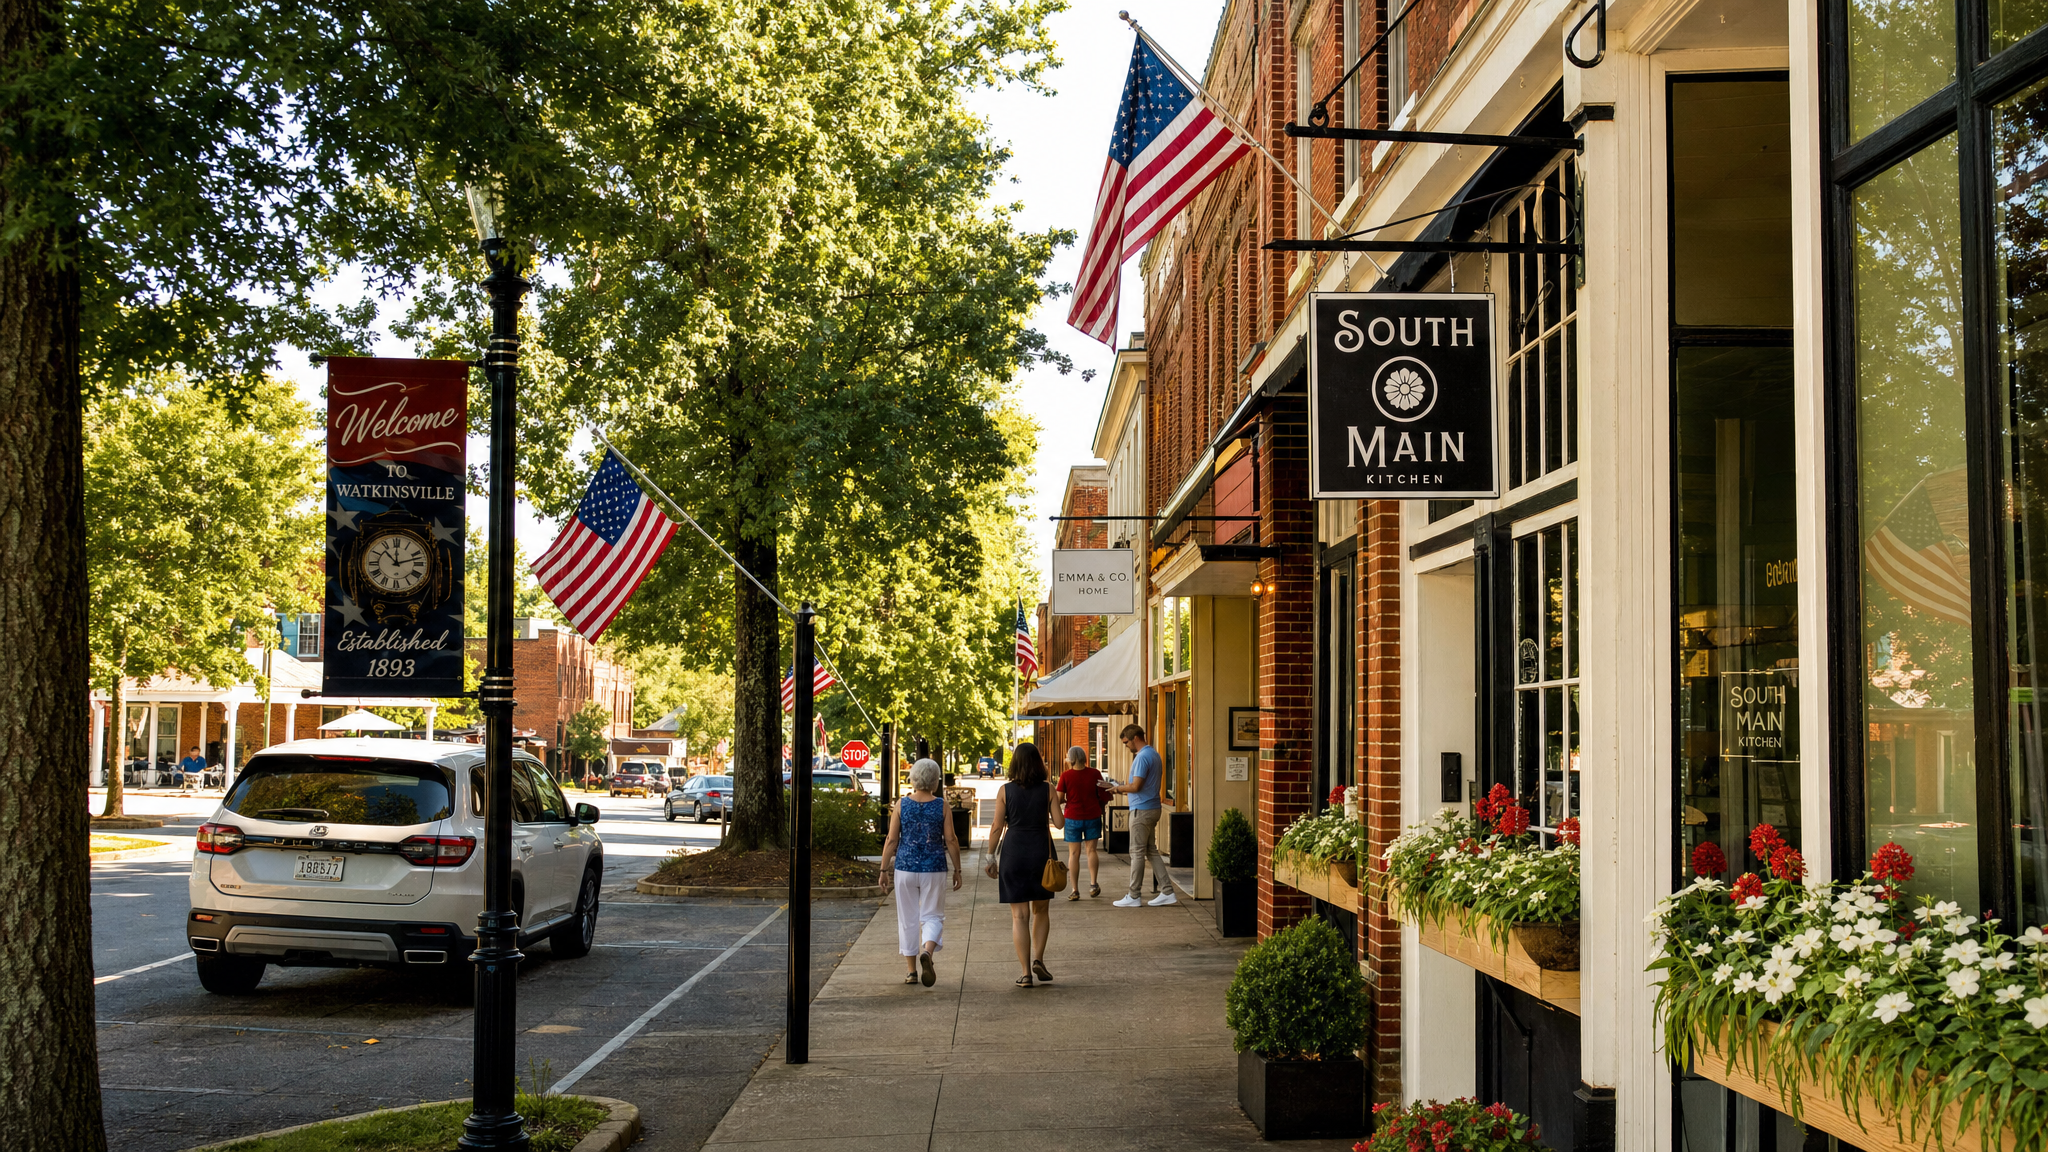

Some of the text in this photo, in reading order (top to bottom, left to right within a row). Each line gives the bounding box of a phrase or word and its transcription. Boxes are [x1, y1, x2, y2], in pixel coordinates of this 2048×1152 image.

[1334, 309, 1474, 353] SOUTH
[335, 396, 459, 446] Welcome
[1346, 425, 1465, 468] MAIN
[386, 464, 408, 479] TO
[1366, 474, 1443, 484] KITCHEN
[336, 484, 455, 500] WATKINSVILLE
[1058, 573, 1129, 582] EMMA & CO.
[337, 628, 449, 652] Established
[366, 658, 416, 677] 1893
[1730, 685, 1786, 708] SOUTH
[1736, 711, 1783, 731] MAIN
[1738, 736, 1782, 748] KITCHEN
[844, 749, 868, 760] STOP
